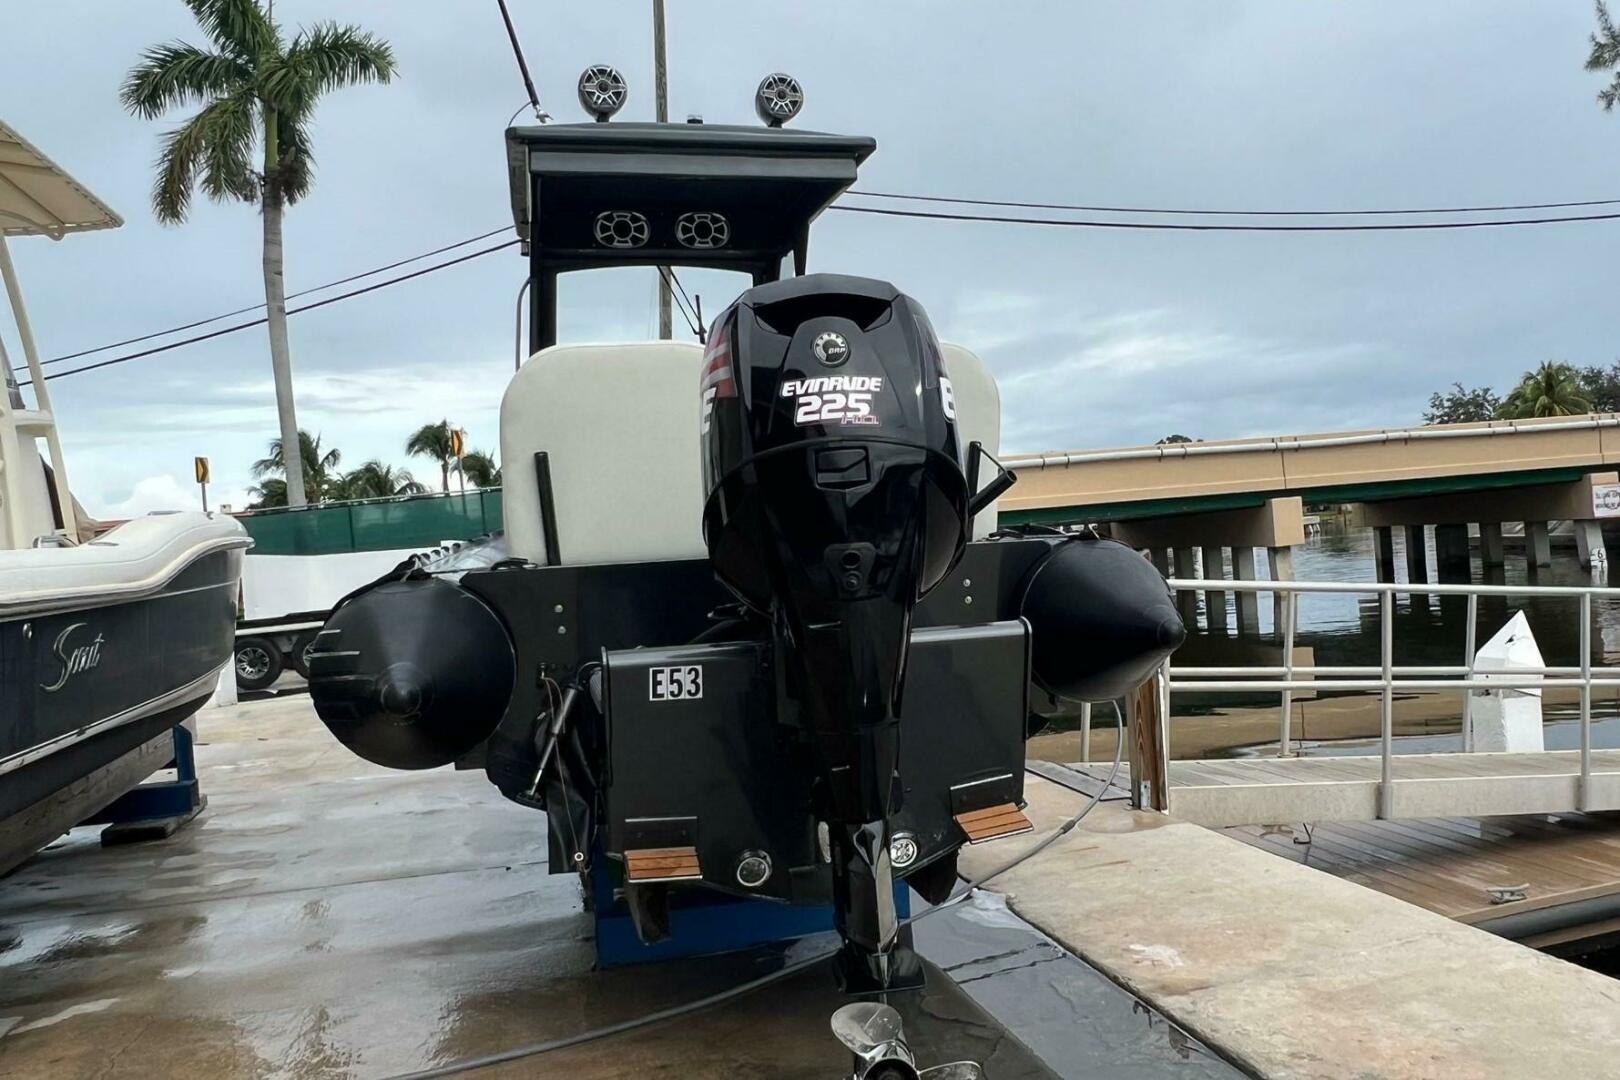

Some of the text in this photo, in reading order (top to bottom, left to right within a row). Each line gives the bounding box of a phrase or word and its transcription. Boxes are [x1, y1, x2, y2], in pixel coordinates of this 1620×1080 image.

[782, 376, 882, 397] EVINRUDE
[797, 393, 872, 423] 225
[652, 667, 701, 699] E53
